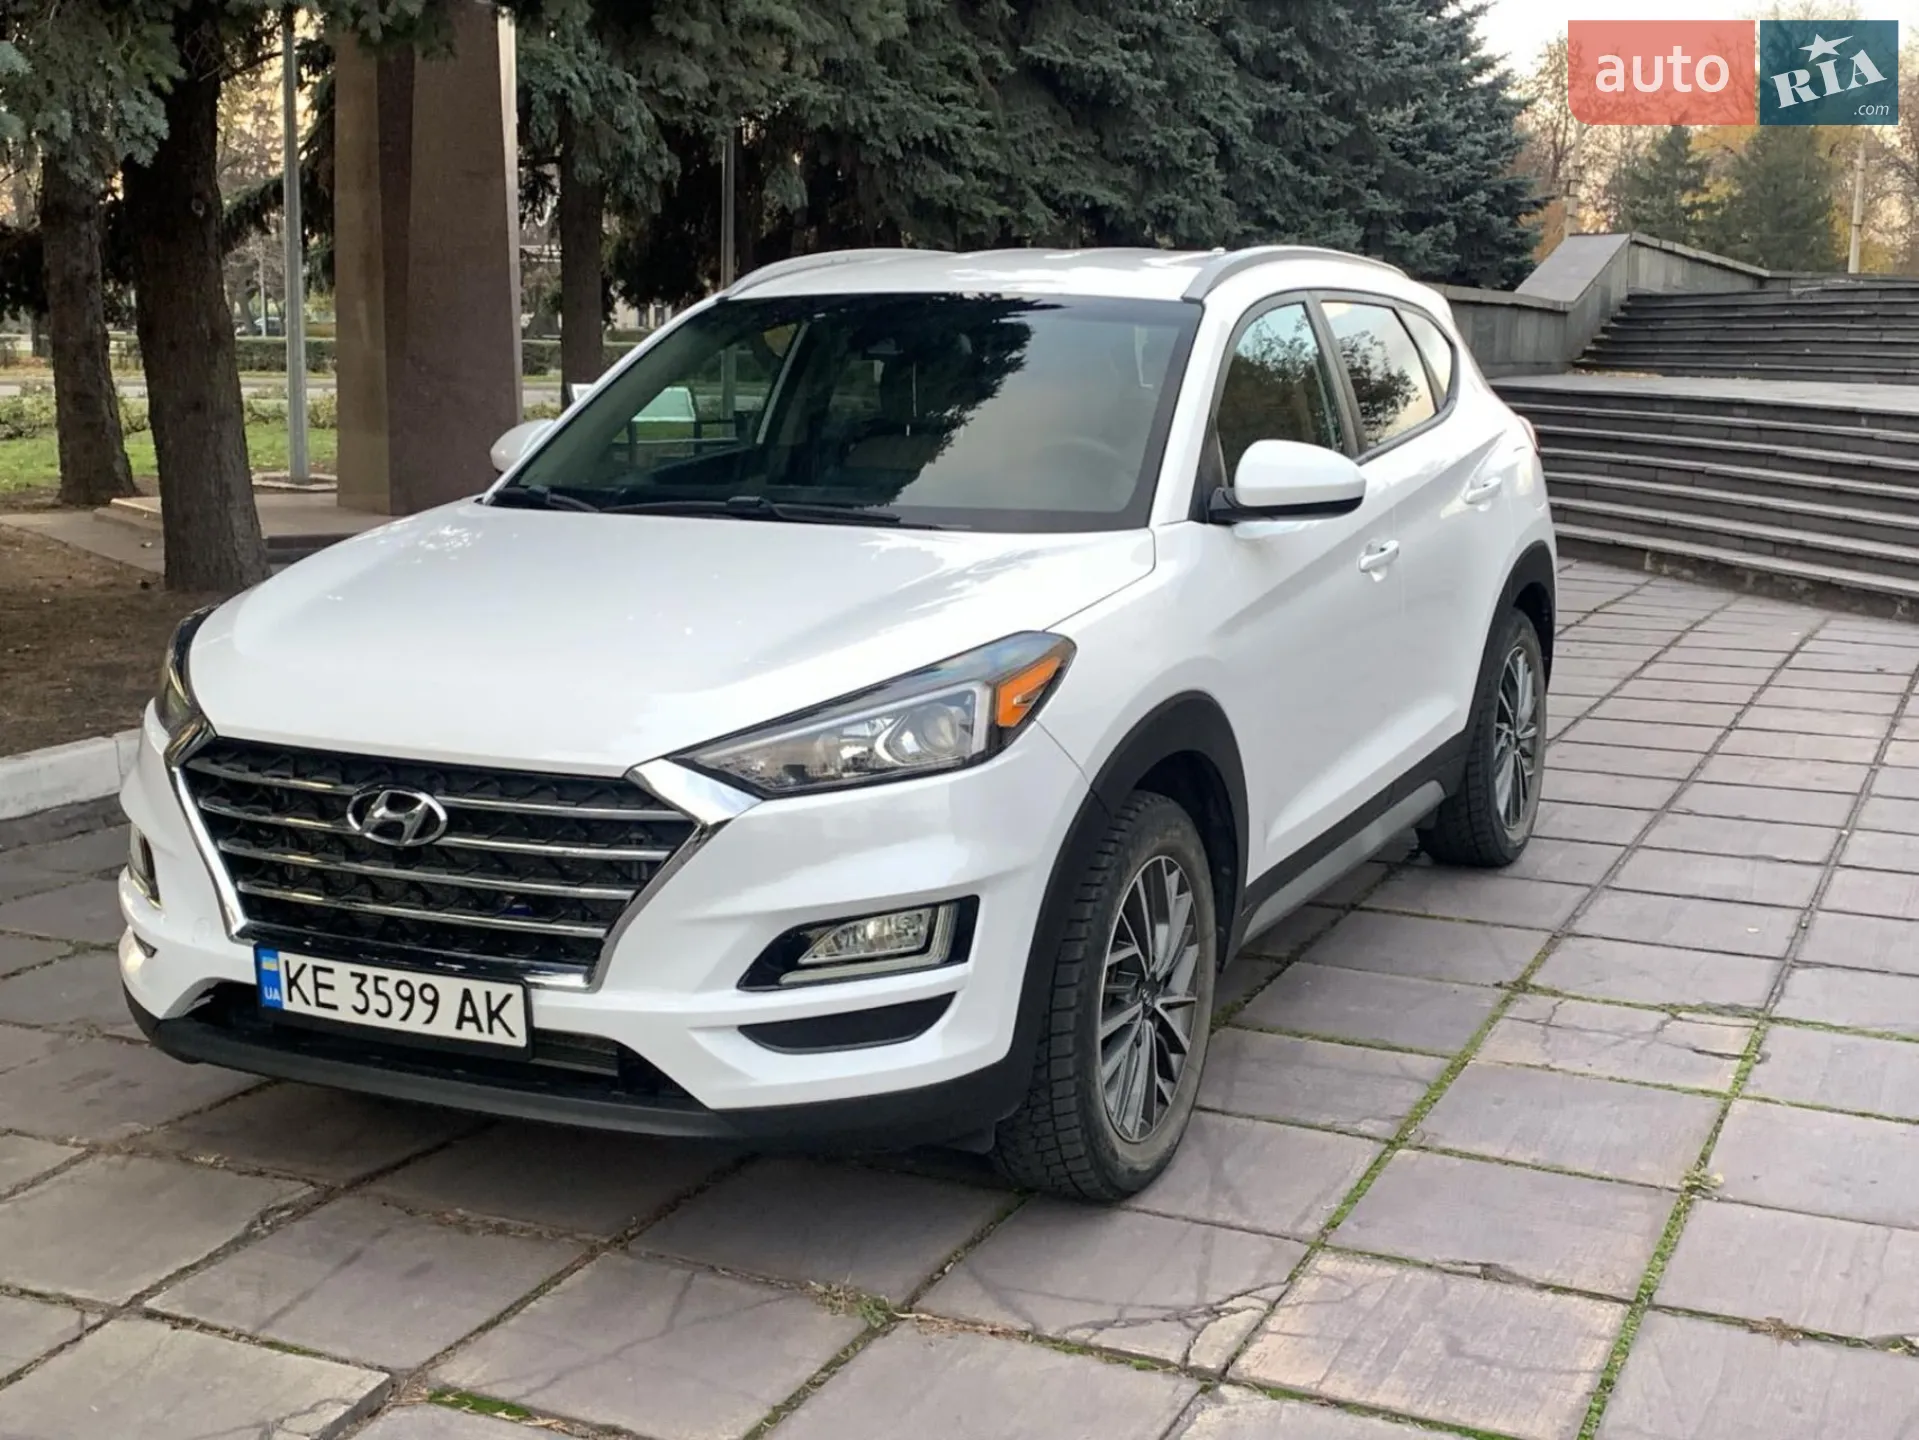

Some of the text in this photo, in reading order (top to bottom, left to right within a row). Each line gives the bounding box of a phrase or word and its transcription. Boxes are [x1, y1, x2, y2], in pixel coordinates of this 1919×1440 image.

[264, 987, 281, 1001] UA
[284, 959, 517, 1038] KE 3599 AK
